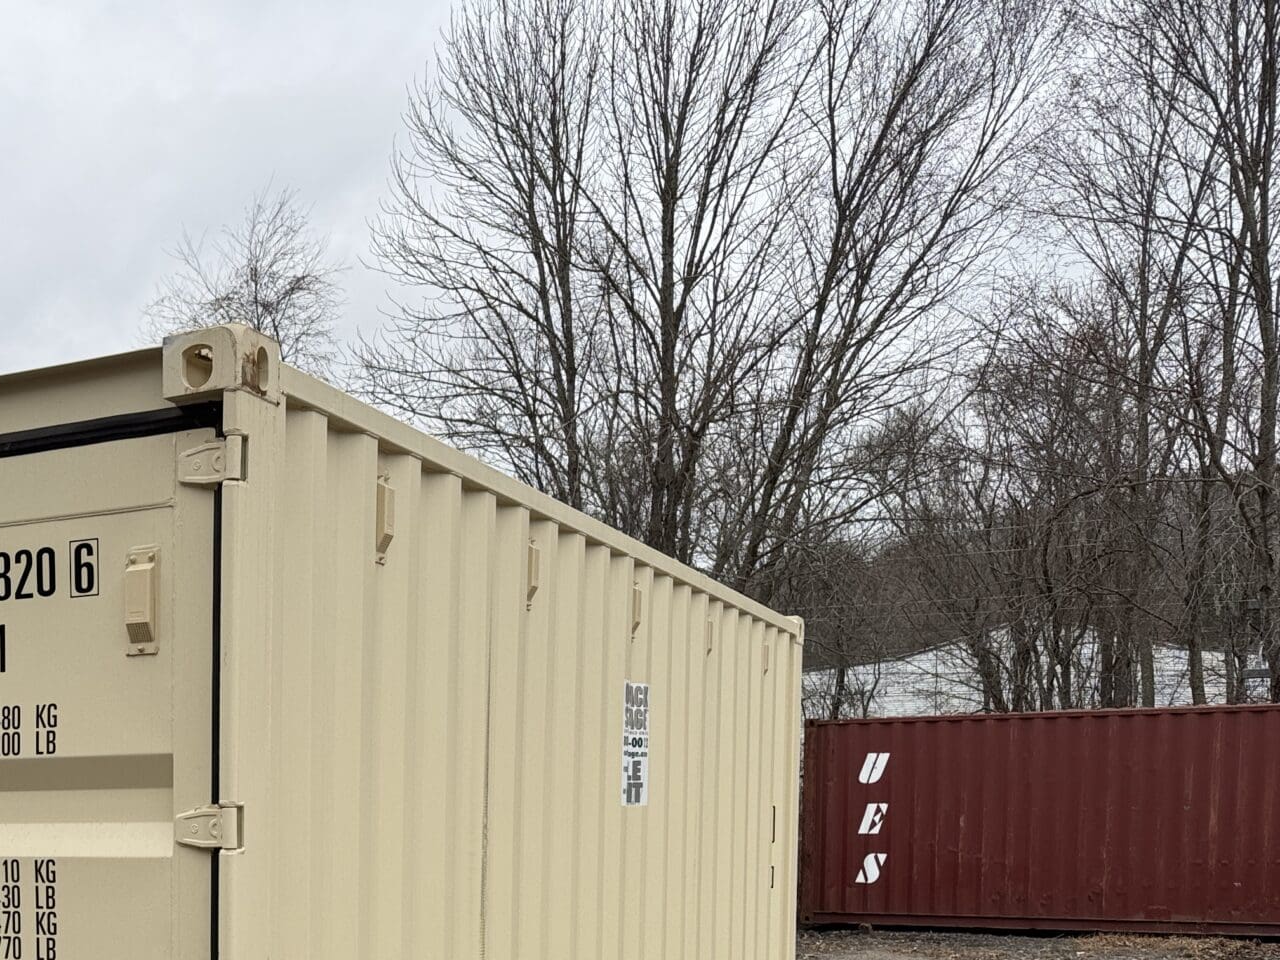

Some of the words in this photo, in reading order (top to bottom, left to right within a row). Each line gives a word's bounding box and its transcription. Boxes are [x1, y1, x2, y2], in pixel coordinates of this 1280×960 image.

[73, 541, 96, 595] 6
[36, 704, 58, 728] KG
[36, 730, 57, 755] LB
[35, 859, 57, 884] KG
[35, 885, 56, 910] LB
[36, 911, 57, 936] KG
